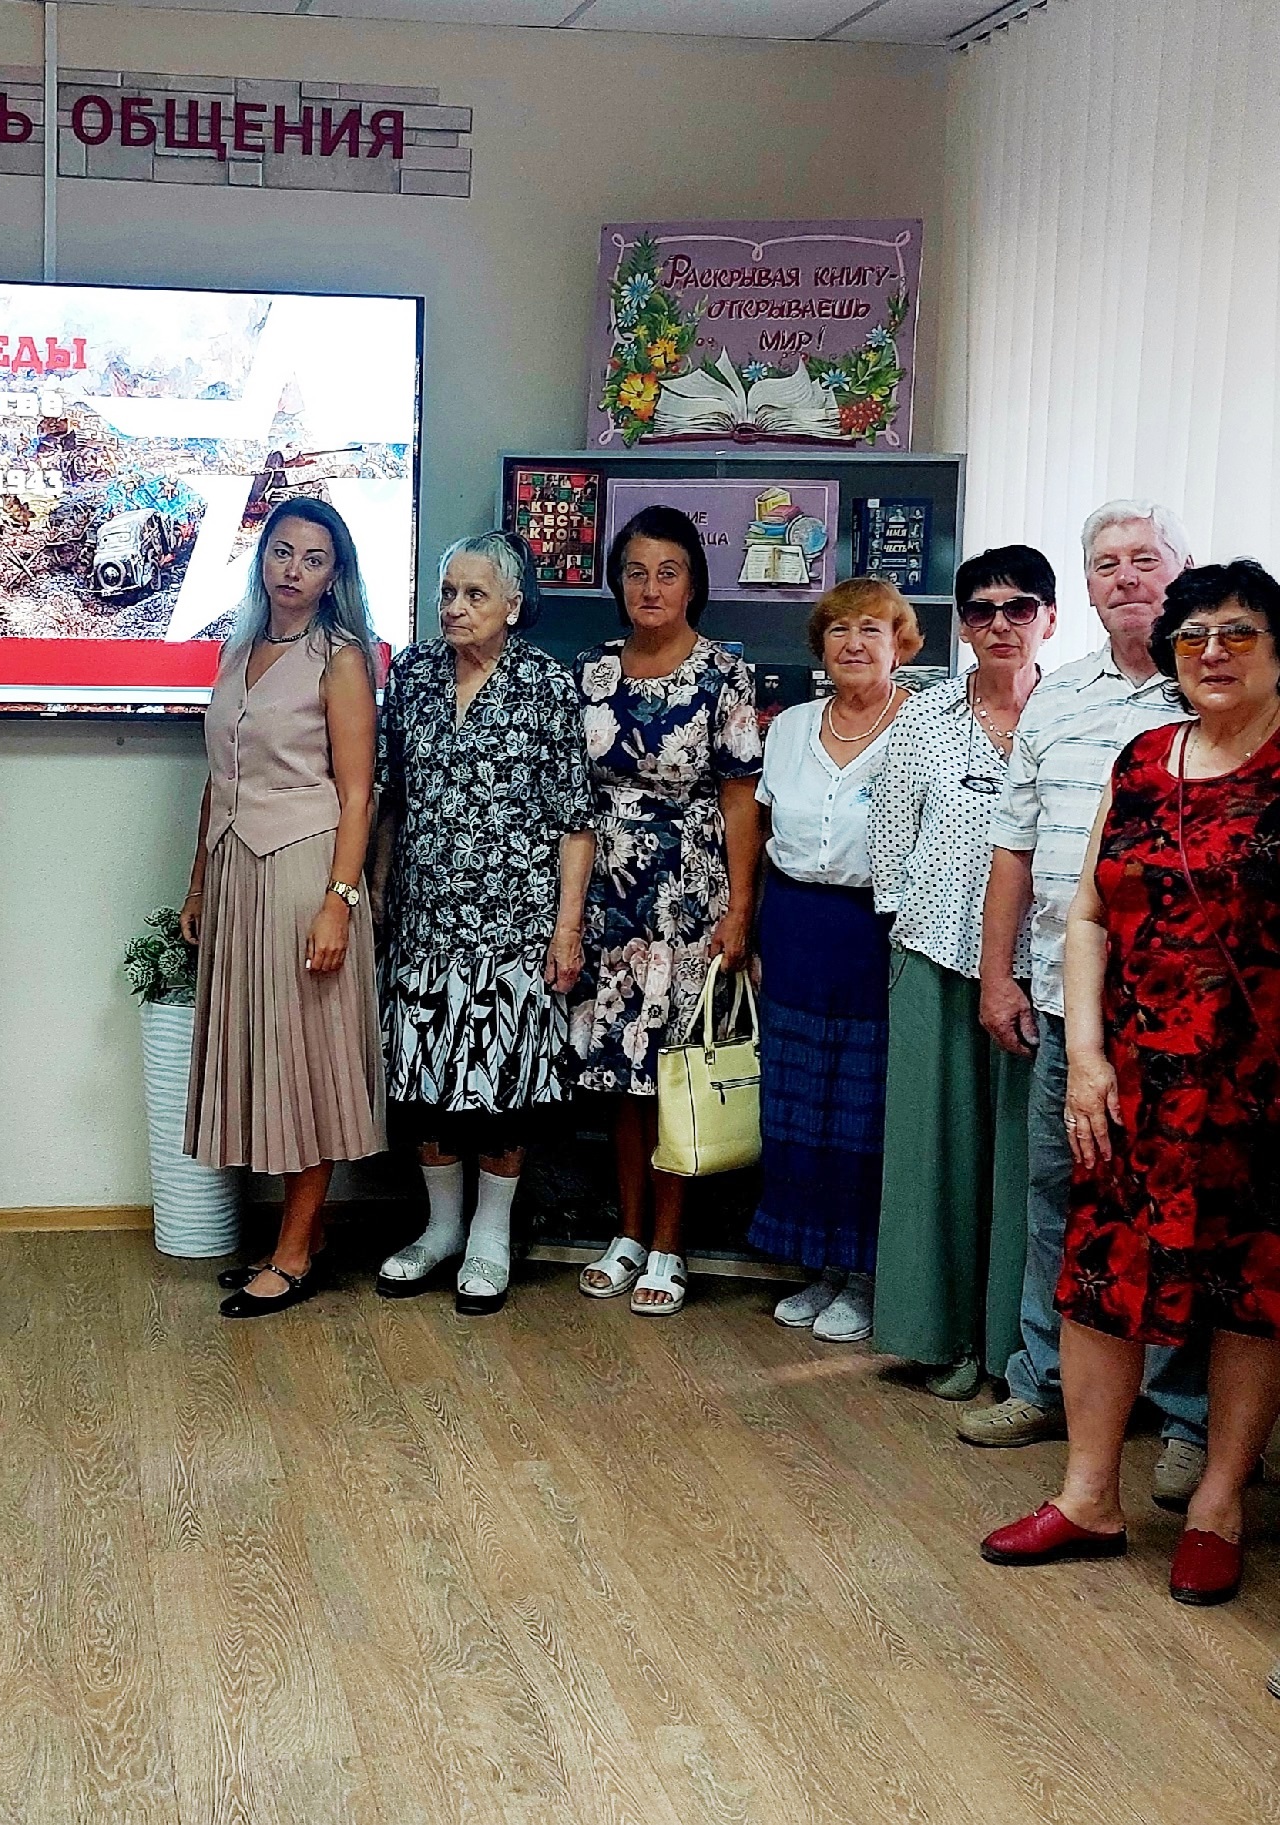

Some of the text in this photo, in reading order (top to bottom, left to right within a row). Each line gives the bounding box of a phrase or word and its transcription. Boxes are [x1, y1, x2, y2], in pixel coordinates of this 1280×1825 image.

[72, 95, 405, 162] ОБЩЕНИЯ
[707, 299, 871, 321] ОТКРЫВАЕШЬ
[531, 501, 569, 514] КТО
